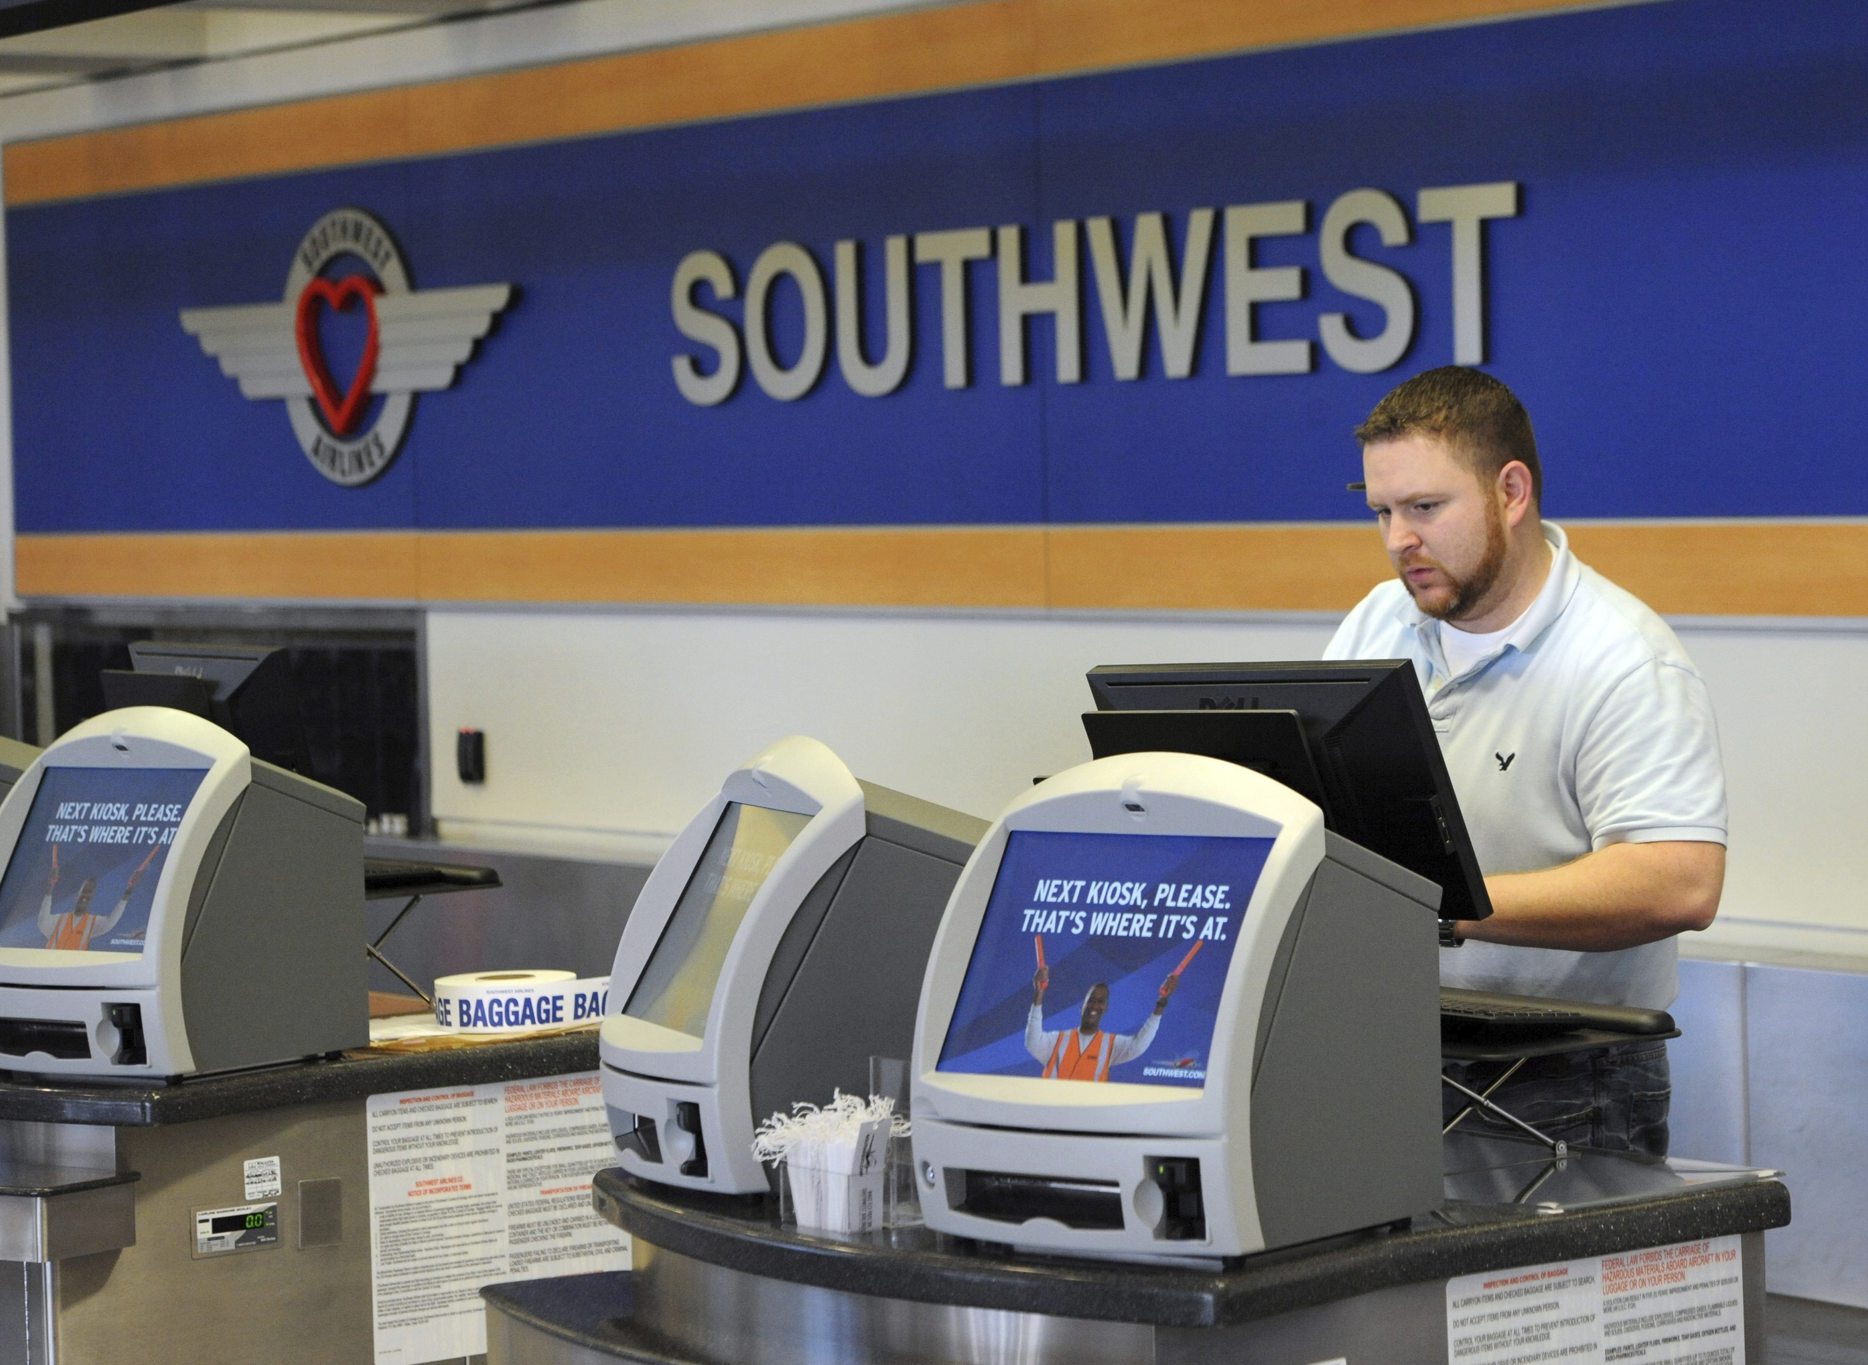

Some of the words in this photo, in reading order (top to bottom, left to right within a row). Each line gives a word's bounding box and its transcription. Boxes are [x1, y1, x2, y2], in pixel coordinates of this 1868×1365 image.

[671, 181, 1517, 406] SOUTHWEST
[311, 429, 388, 478] AIRLINES
[56, 802, 90, 820] NEXT
[89, 803, 130, 823] KIOSK,
[132, 804, 182, 822] PLEASE.
[45, 825, 88, 842] THAT'S
[89, 826, 132, 844] WHERE
[132, 827, 159, 844] IT'S
[1033, 879, 1086, 903] NEXT
[1086, 881, 1148, 909] KIOSK,
[1154, 883, 1232, 909] PLEASE.
[1021, 909, 1087, 935] THAT'S
[1089, 913, 1157, 938] WHERE
[1158, 915, 1198, 940] IT'S
[1199, 917, 1229, 941] AT.
[459, 995, 564, 1028] BAGGAGE
[1602, 1256, 1625, 1270] FEDERAL
[1626, 1254, 1639, 1266] LAW
[1640, 1250, 1662, 1264] FORBIDS
[1664, 1248, 1674, 1260] THE
[1674, 1244, 1702, 1259] CARRIAGE
[1702, 1242, 1710, 1254] OF
[1602, 1266, 1635, 1282] HAZARDOUS
[1636, 1261, 1666, 1276] MATERIALS
[1666, 1258, 1688, 1271] ABOARD
[1688, 1253, 1714, 1267] AIRCRAFT
[1714, 1252, 1721, 1263] IN
[1721, 1250, 1736, 1262] YOUR
[1603, 1280, 1629, 1295] LUGGAGE
[1630, 1279, 1638, 1291] OR
[1639, 1277, 1647, 1289] ON
[1648, 1274, 1664, 1288] YOUR
